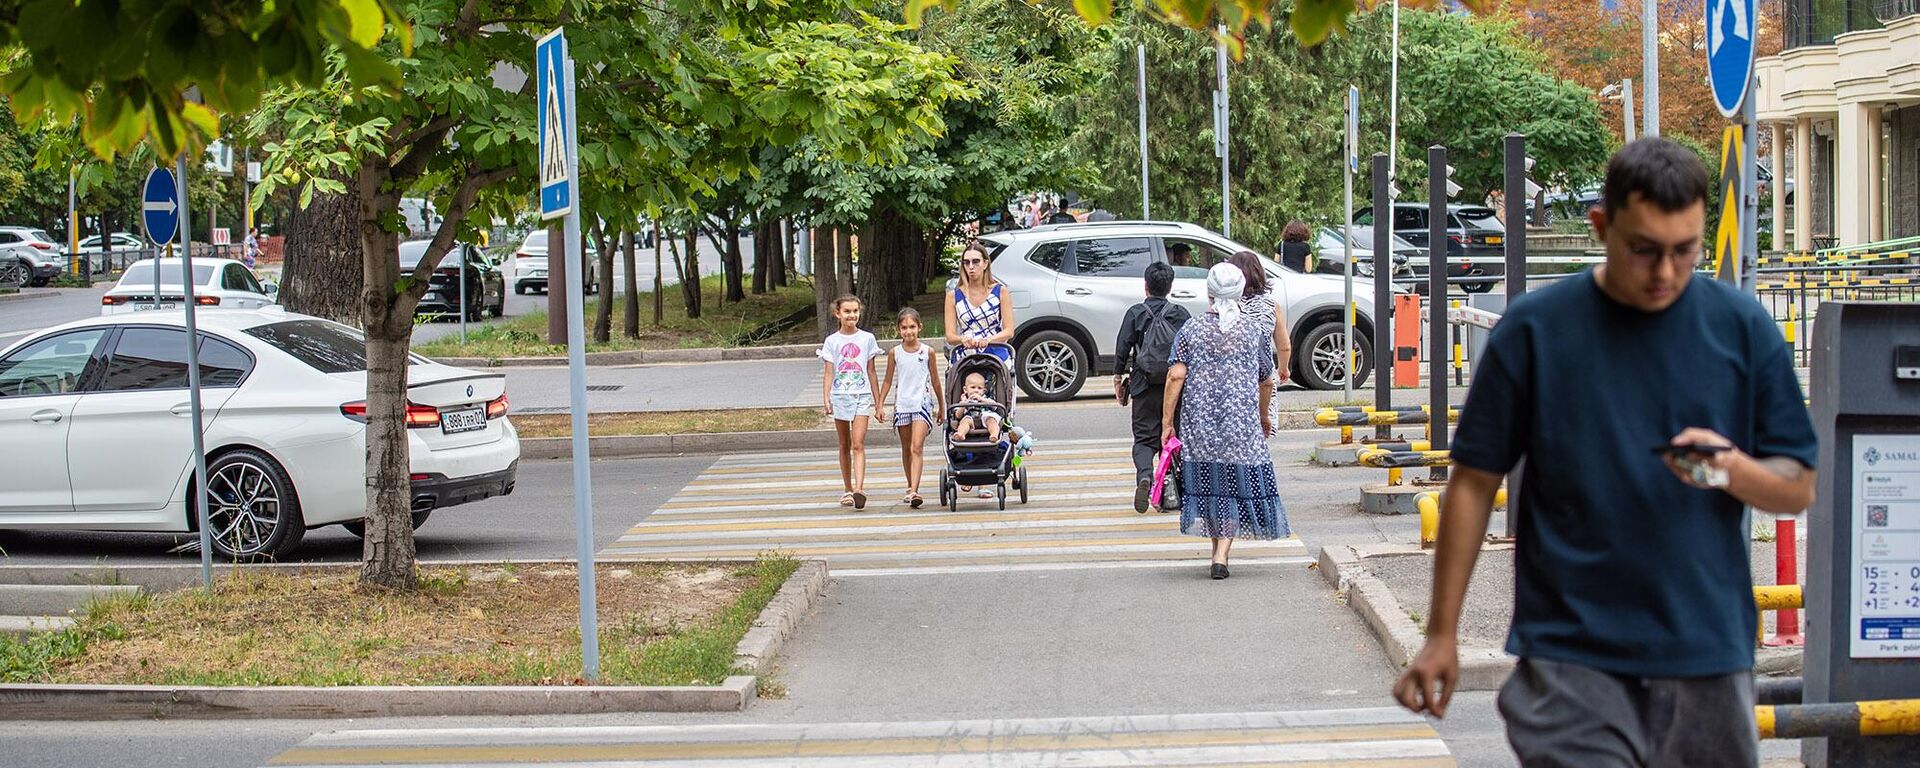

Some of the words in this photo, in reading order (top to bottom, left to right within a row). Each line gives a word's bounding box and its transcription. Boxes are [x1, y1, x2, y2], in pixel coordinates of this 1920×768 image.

[1864, 566, 1879, 579] 15
[1869, 582, 1878, 594] 2
[1864, 598, 1878, 610] +1
